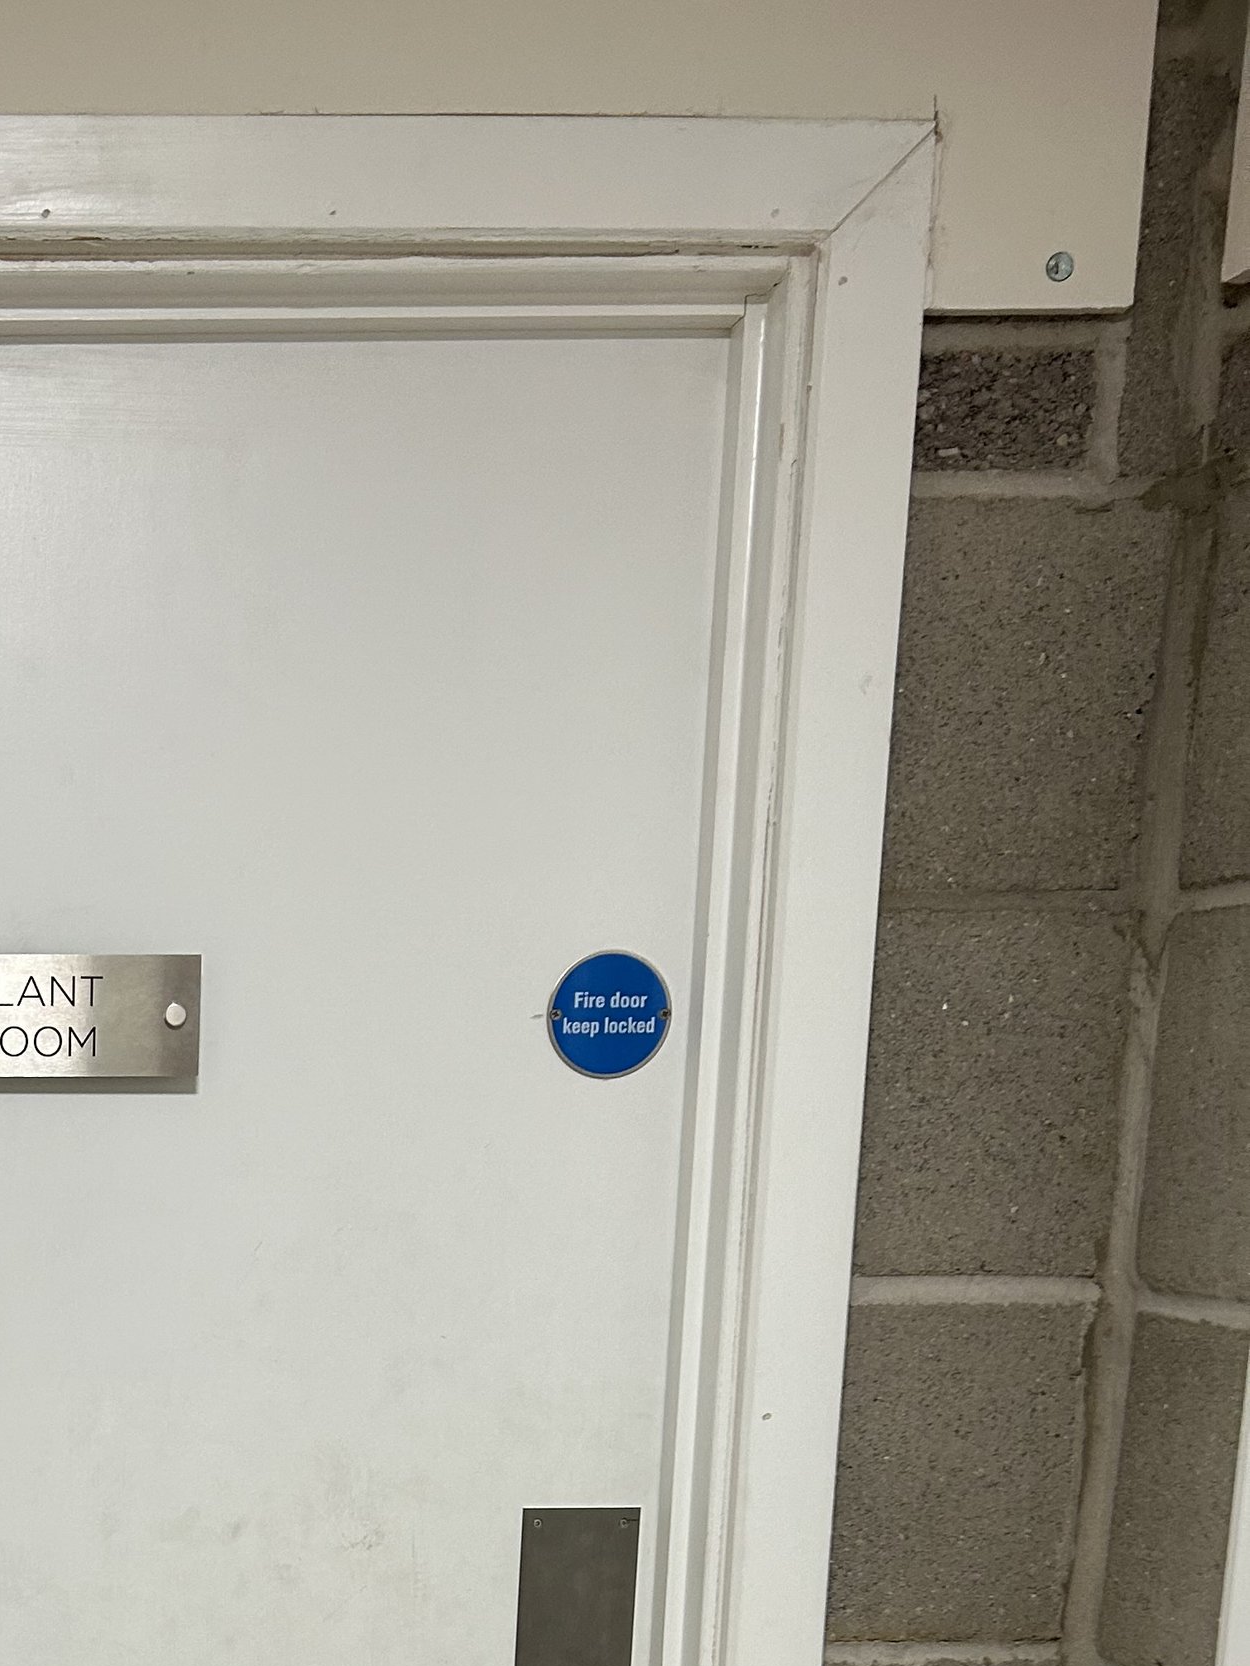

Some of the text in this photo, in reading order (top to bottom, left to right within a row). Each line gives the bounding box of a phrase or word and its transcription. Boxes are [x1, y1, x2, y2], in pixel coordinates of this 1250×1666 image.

[574, 991, 648, 1008] Fire door
[562, 1016, 656, 1038] keep locked
